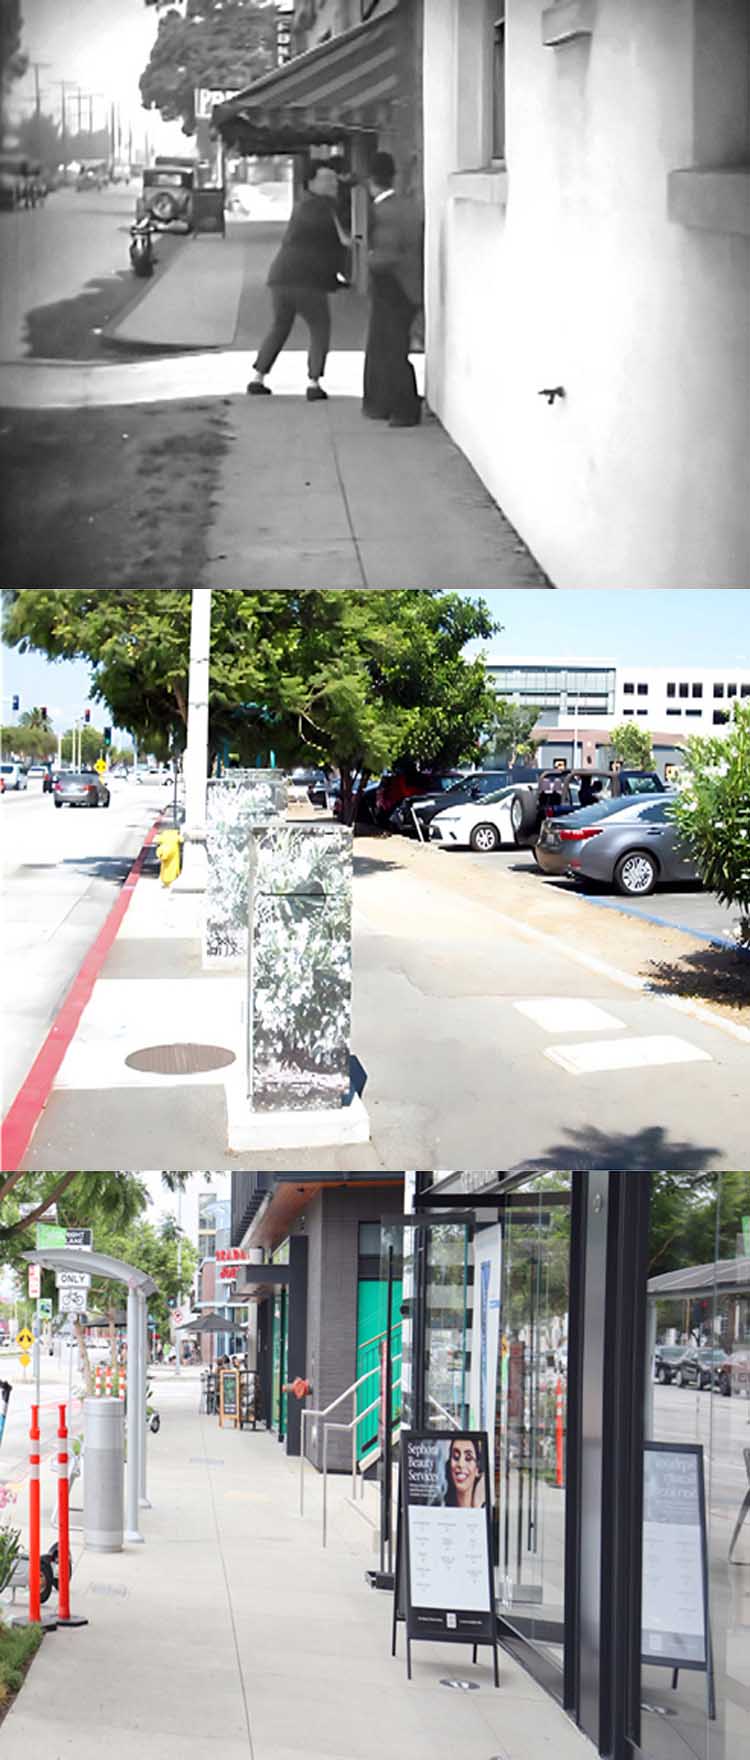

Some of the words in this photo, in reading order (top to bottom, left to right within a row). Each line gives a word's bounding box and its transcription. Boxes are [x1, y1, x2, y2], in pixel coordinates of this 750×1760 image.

[60, 1274, 85, 1284] ONLY
[407, 1442, 439, 1457] Sephora
[408, 1456, 434, 1472] Beauty
[408, 1469, 439, 1482] Services
